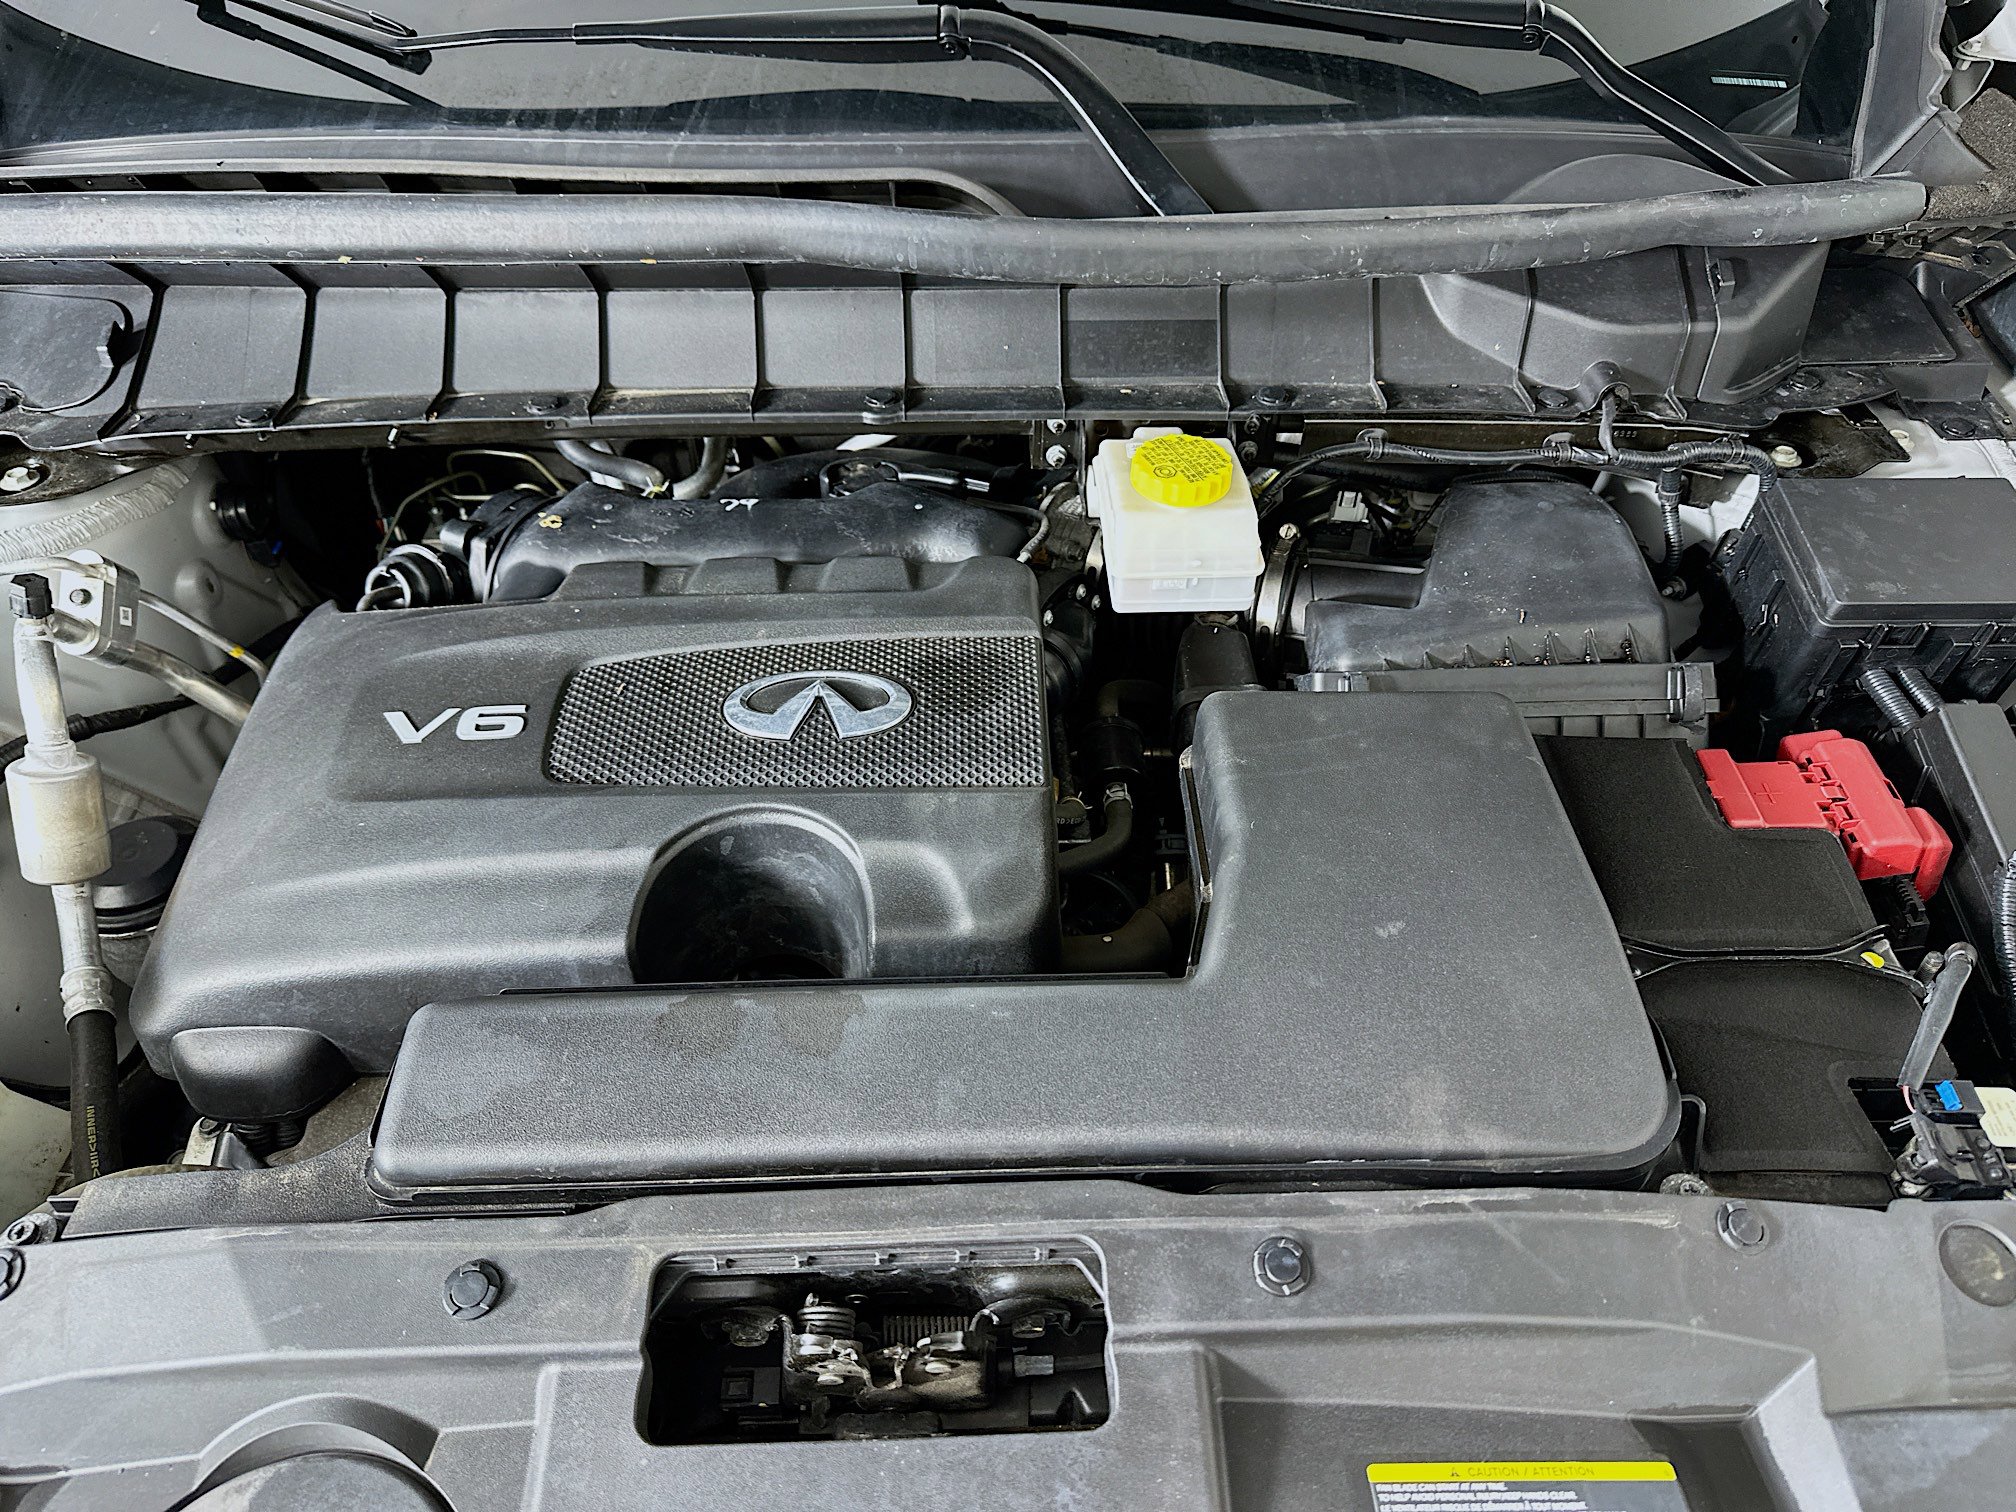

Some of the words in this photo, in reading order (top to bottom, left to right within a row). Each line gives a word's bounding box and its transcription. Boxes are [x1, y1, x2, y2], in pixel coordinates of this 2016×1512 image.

[382, 704, 527, 744] V6
[1467, 1467, 1520, 1477] CAUTION
[1533, 1466, 1595, 1476] ATTENTION
